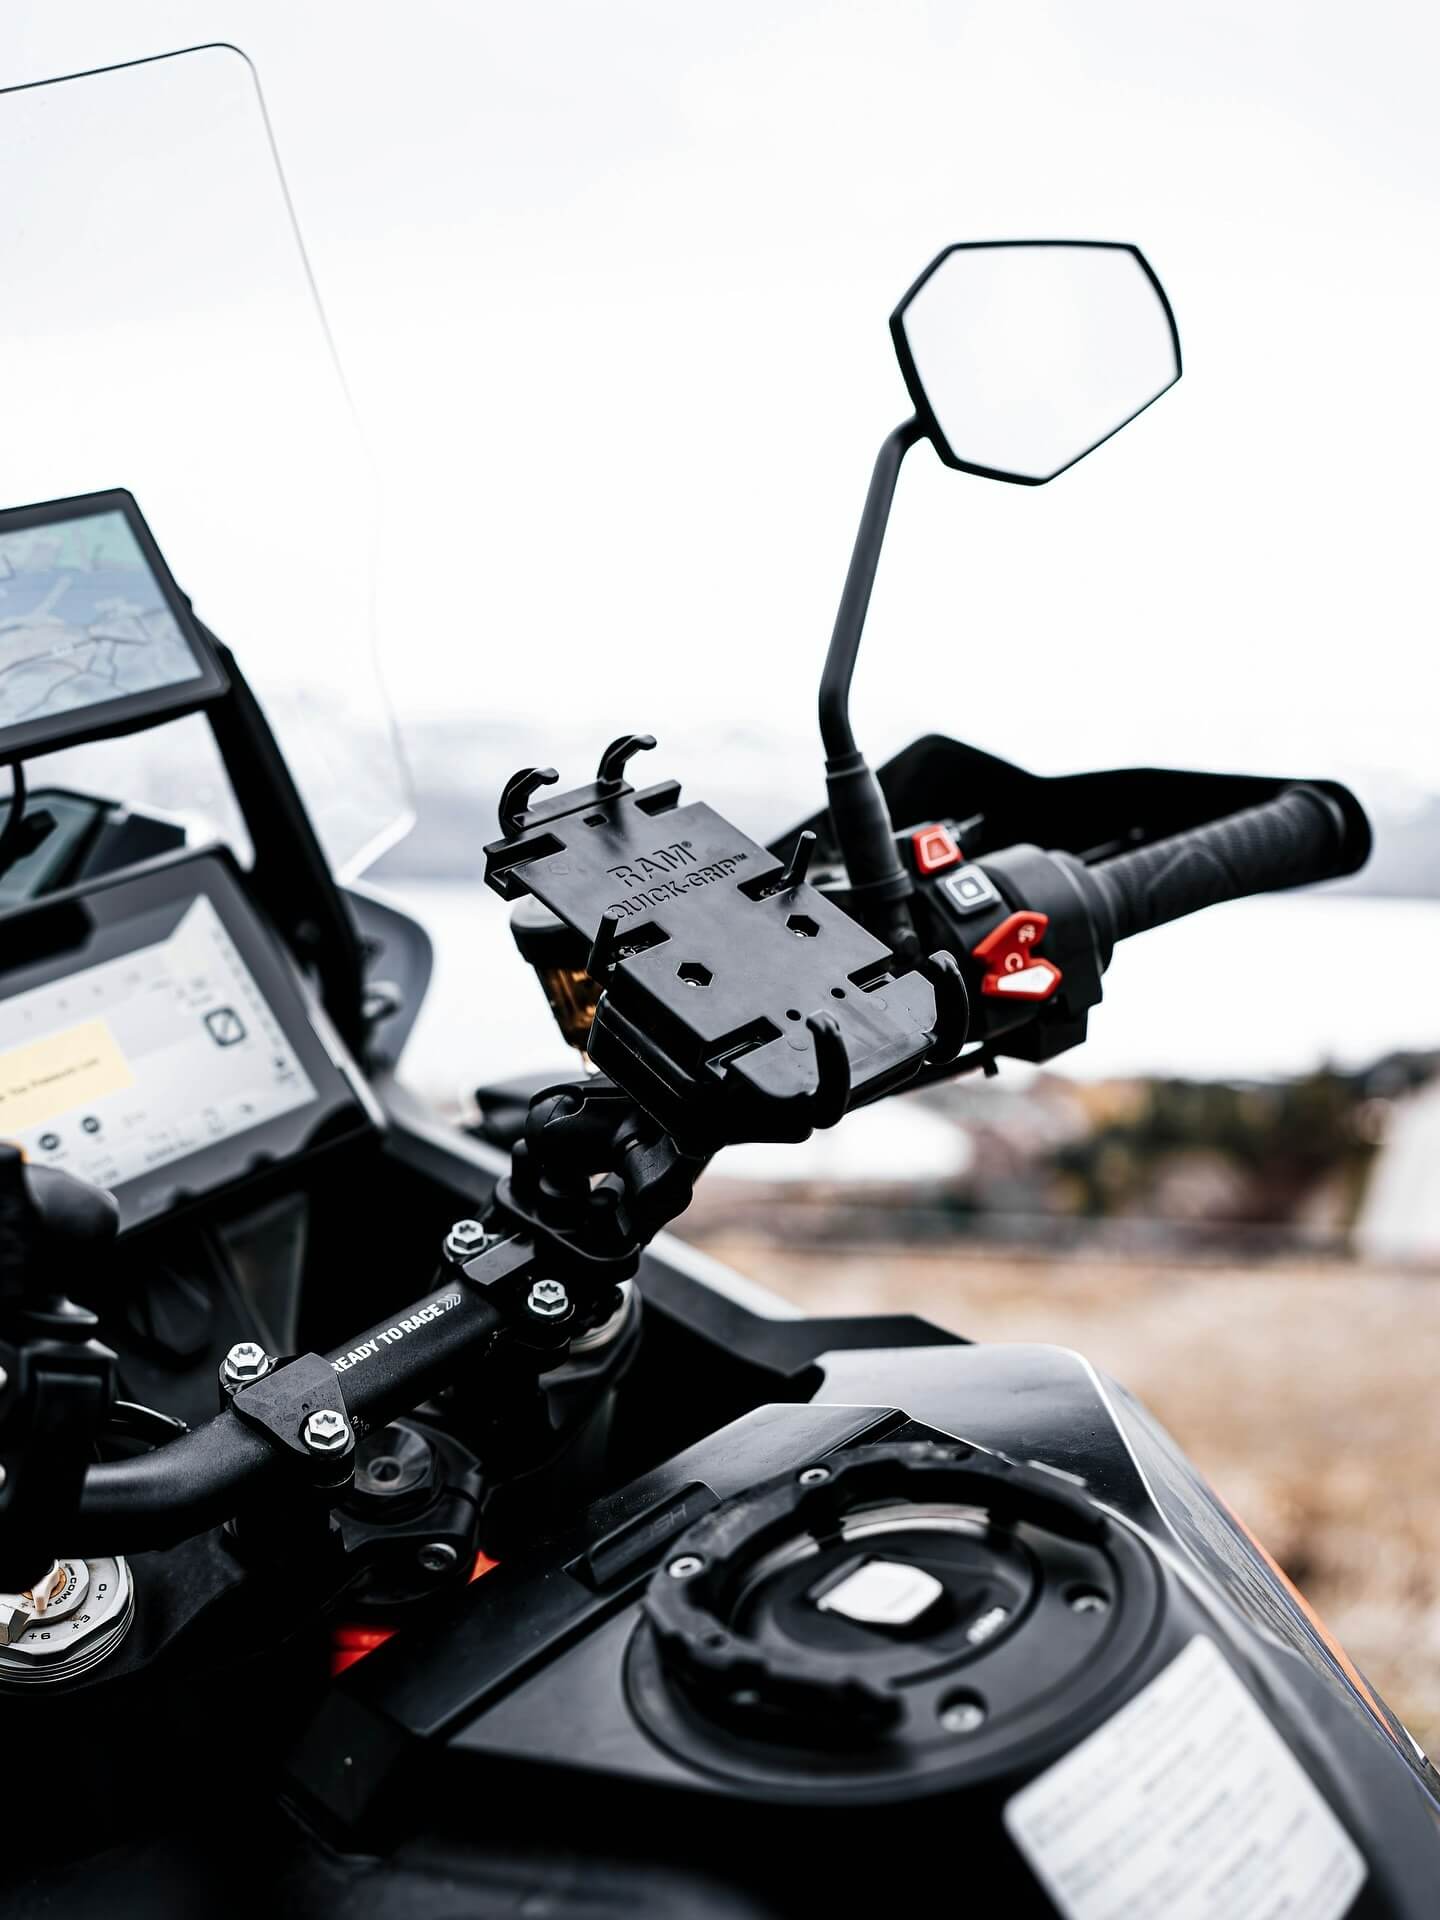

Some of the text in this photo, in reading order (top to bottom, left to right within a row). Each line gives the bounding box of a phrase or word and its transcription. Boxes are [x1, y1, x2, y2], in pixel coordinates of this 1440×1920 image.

[376, 1327, 403, 1345] TO
[399, 1303, 445, 1334] RACE
[54, 1577, 77, 1605] COMP
